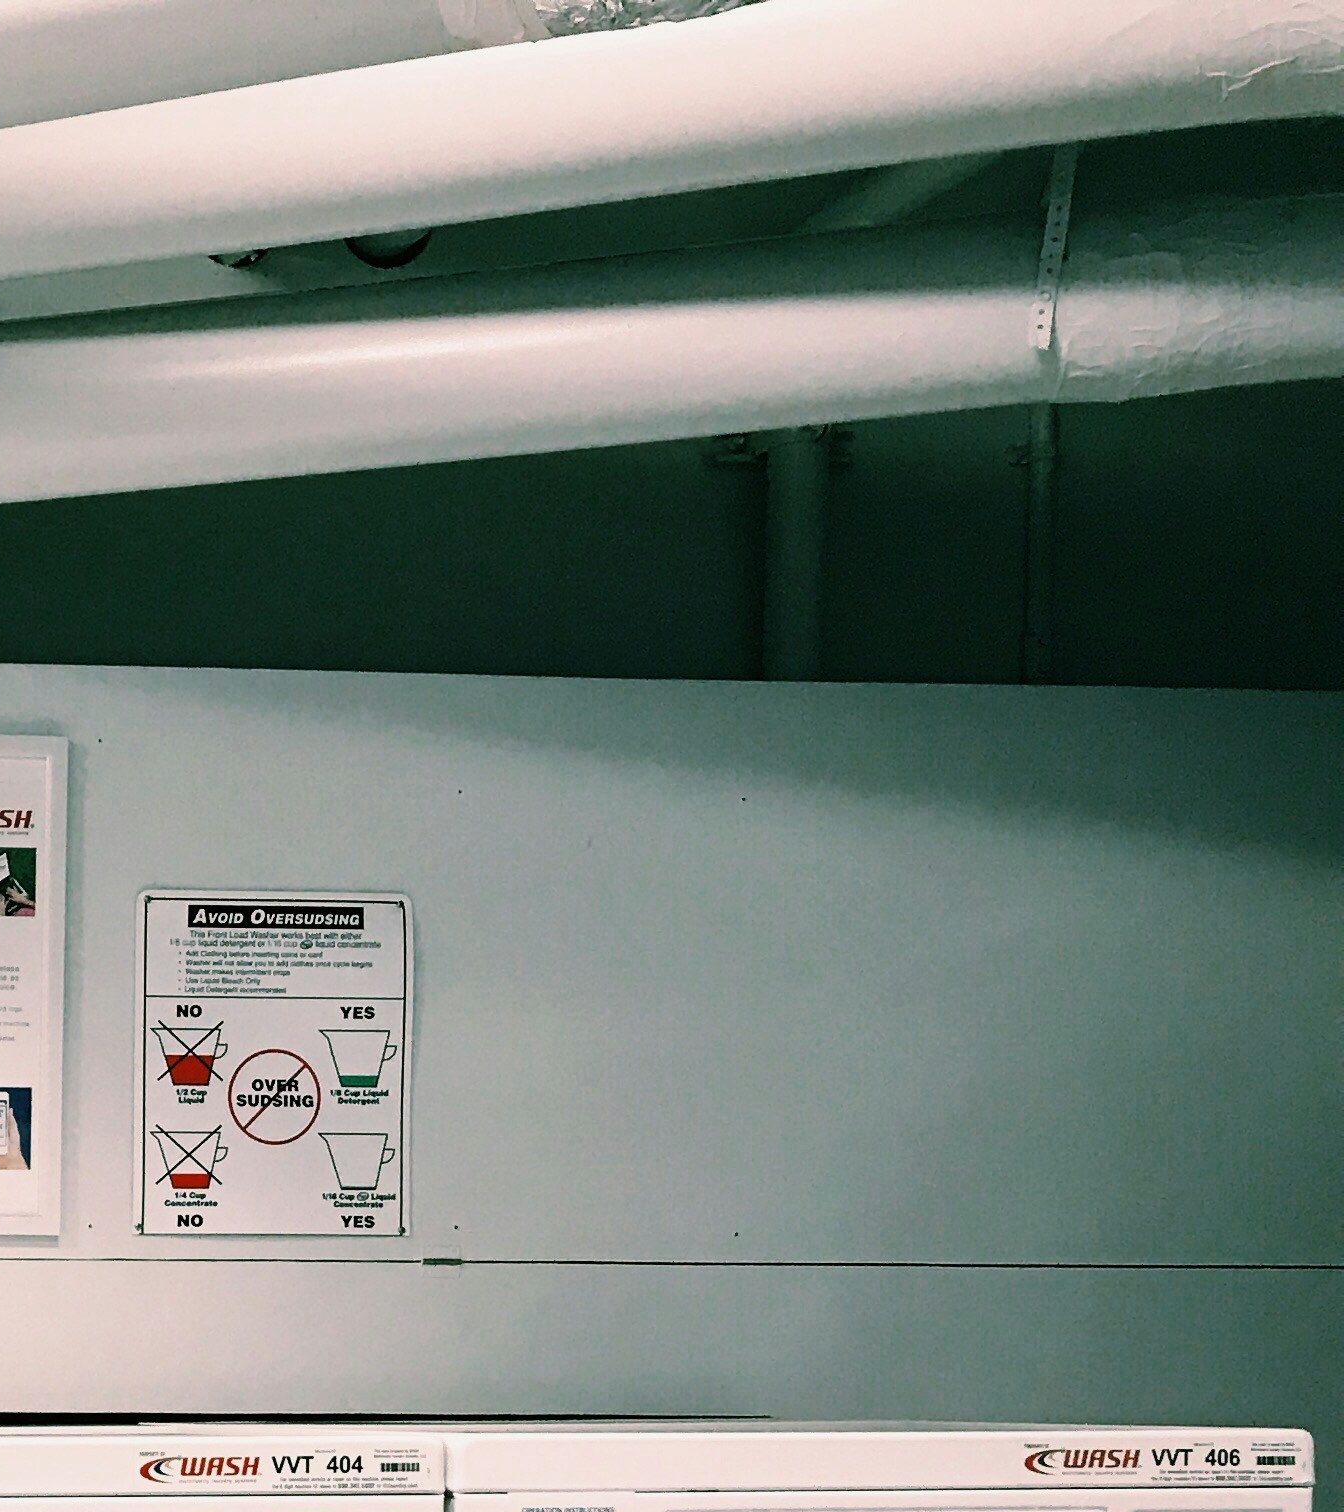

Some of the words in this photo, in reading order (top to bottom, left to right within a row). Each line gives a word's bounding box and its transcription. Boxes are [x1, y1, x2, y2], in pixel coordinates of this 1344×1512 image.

[193, 909, 243, 924] AVOID
[251, 909, 359, 926] OVERSUDSING
[177, 1005, 202, 1017] NO
[341, 1007, 375, 1019] YES
[252, 1079, 299, 1091] OVER
[178, 1097, 204, 1105] Liquid
[236, 1095, 313, 1108] SUDSING
[338, 1097, 380, 1105] Detergent
[177, 1215, 203, 1228] NO
[341, 1216, 375, 1228] YES
[1063, 1449, 1141, 1468] WASH
[1152, 1449, 1193, 1466] VVT
[1205, 1449, 1240, 1466] 406
[181, 1457, 260, 1476] WASH
[272, 1456, 314, 1473] VVT
[326, 1456, 363, 1473] 404
